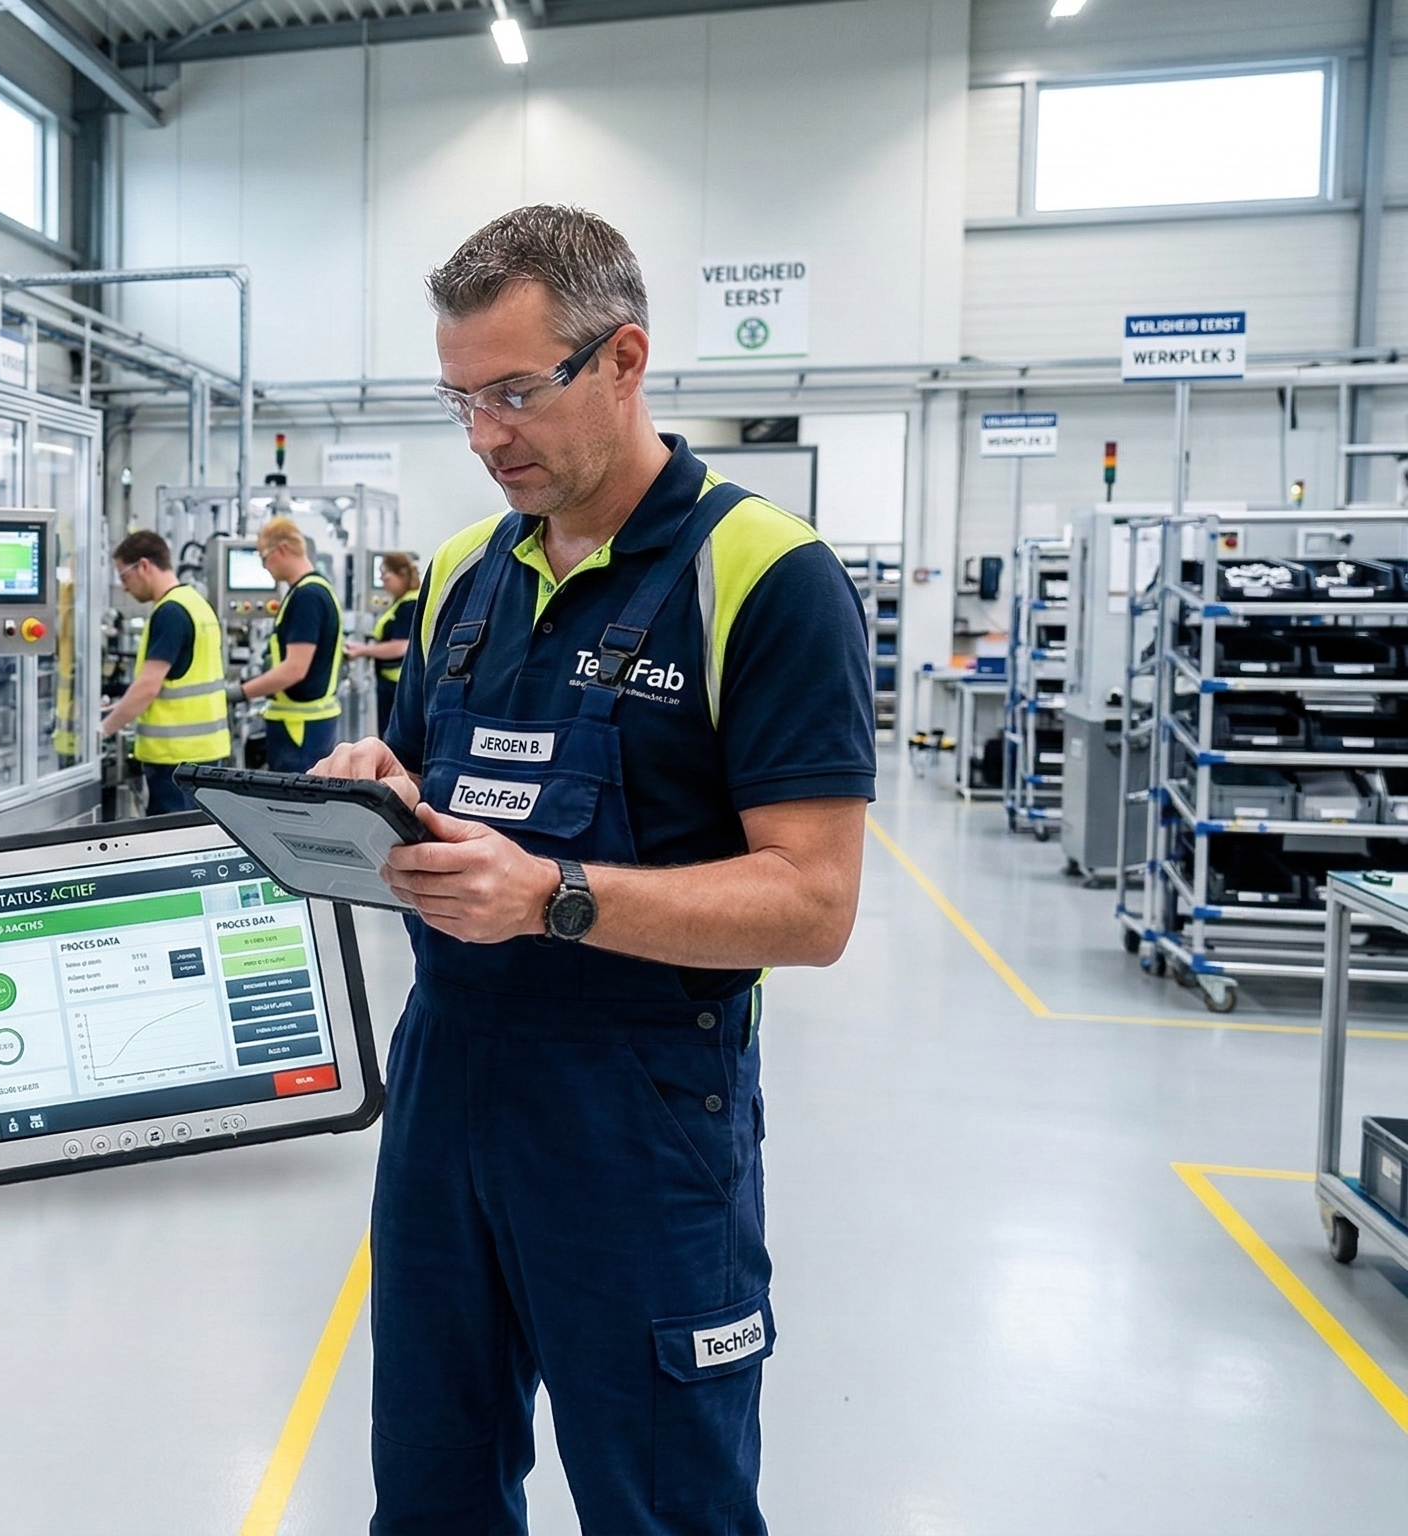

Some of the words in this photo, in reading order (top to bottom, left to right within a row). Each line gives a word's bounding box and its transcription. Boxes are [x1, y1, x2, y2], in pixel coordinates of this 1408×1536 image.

[702, 262, 806, 283] VEILIGHEID
[724, 288, 783, 307] EERST
[1133, 348, 1222, 365] WERKPLEK
[1226, 348, 1236, 363] 3
[575, 650, 685, 691] TeFab
[480, 736, 527, 753] JEROEN
[530, 740, 542, 754] B.
[458, 784, 531, 810] TechFab
[49, 883, 97, 900] ACTIEF
[97, 937, 120, 948] DATA
[701, 1323, 762, 1356] TechFab
